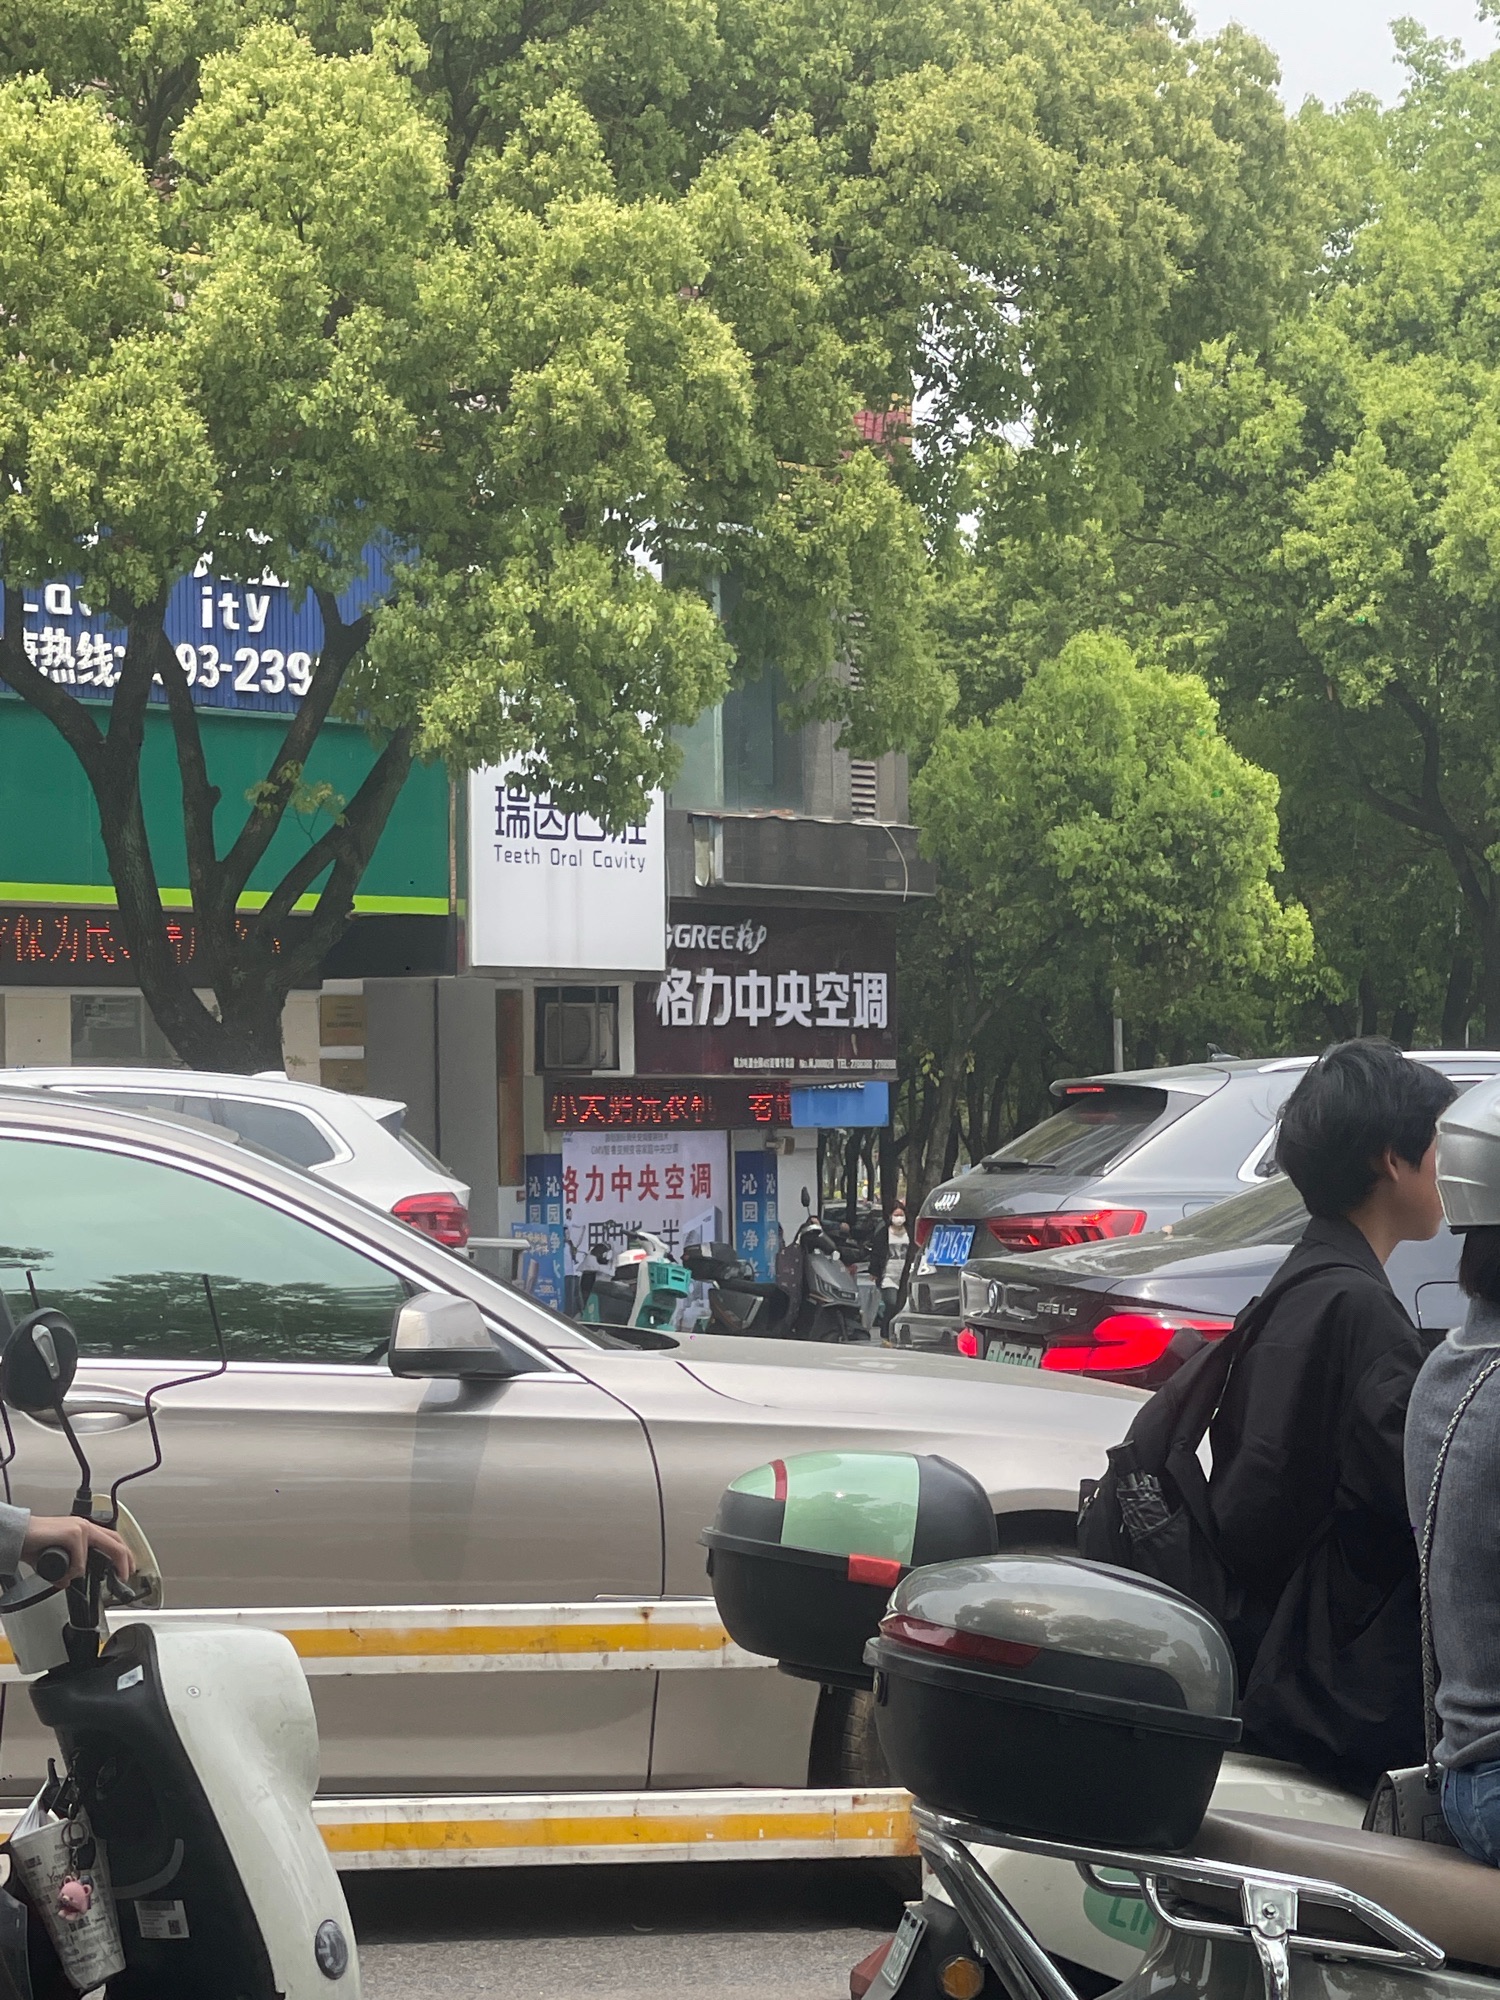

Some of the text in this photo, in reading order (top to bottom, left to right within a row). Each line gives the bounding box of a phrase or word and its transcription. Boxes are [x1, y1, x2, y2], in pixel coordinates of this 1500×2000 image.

[493, 844, 646, 873] Teeth Oral Cavity
[674, 923, 736, 950] GREE
[656, 967, 888, 1029] 格力中央空调
[562, 1162, 712, 1205] 格力中央空调
